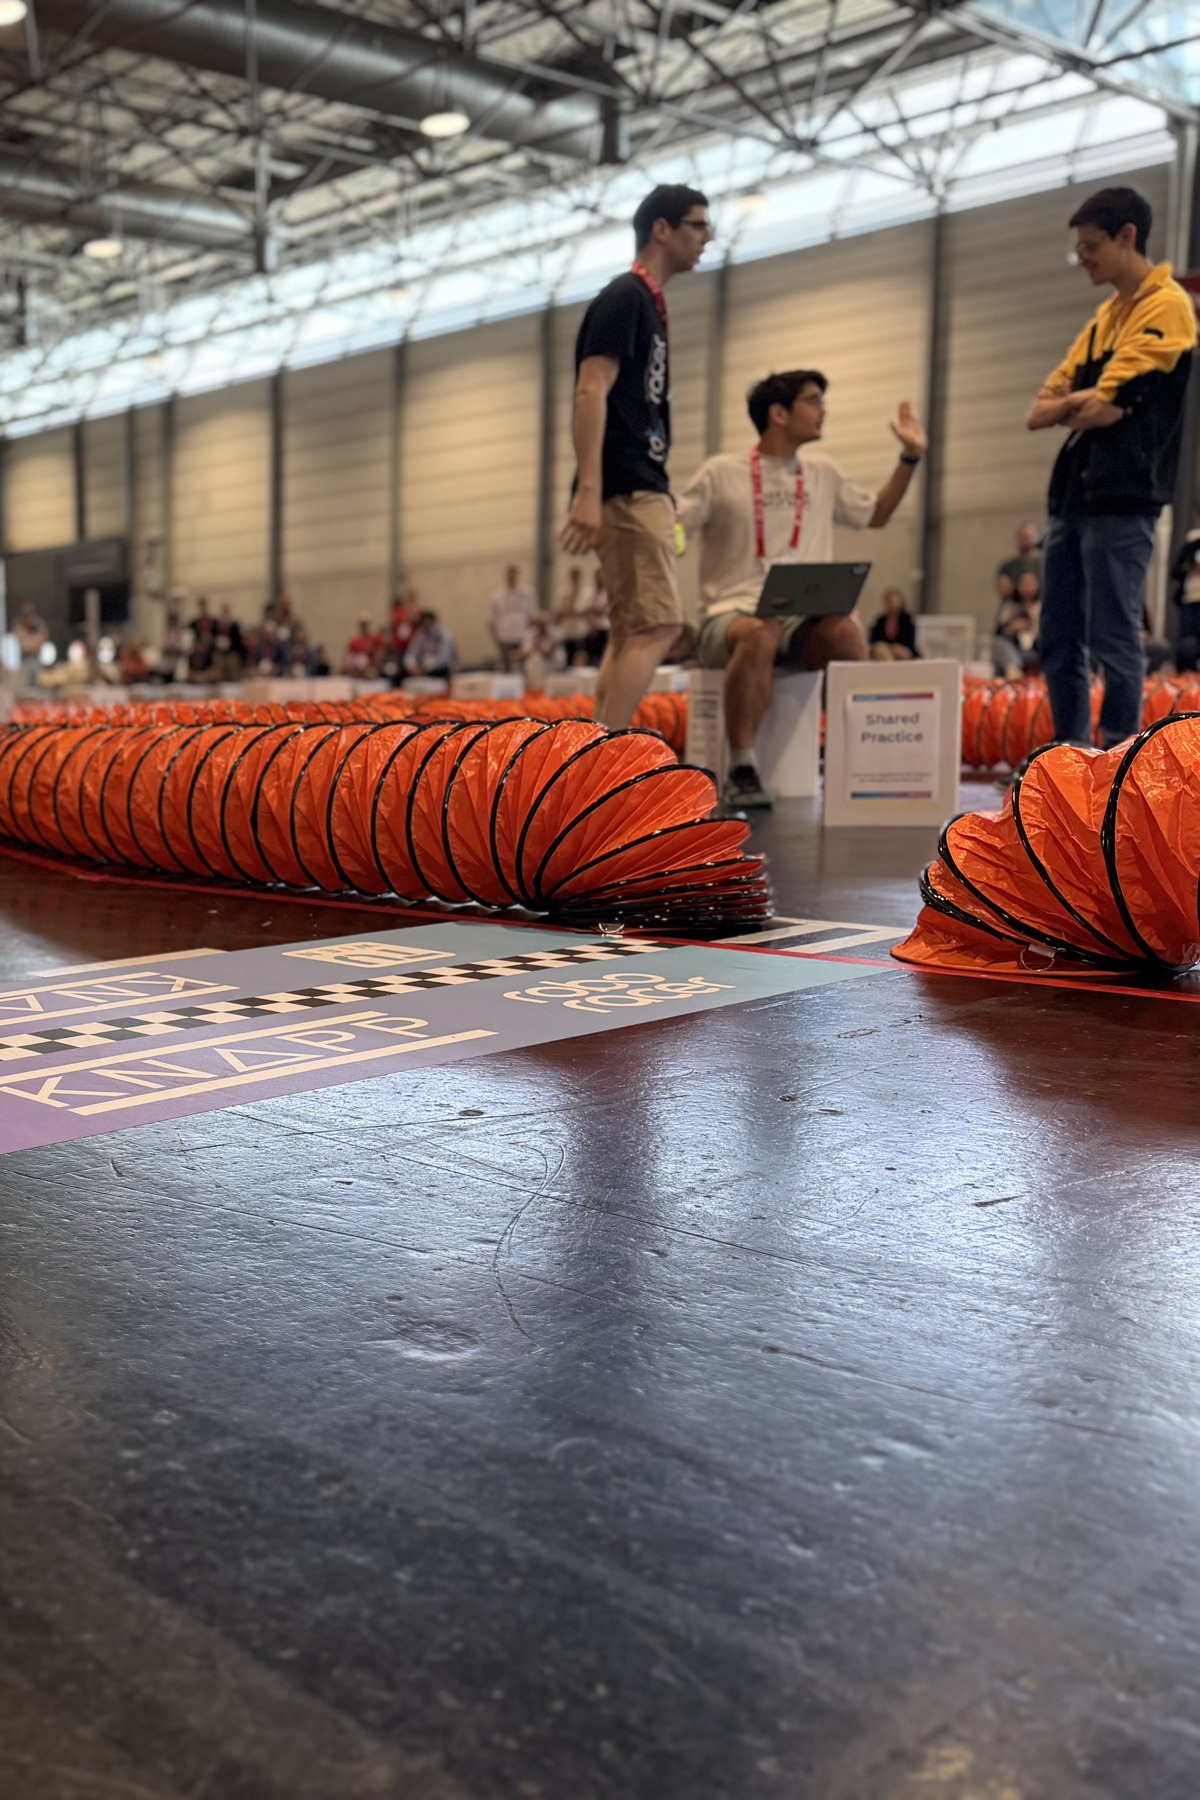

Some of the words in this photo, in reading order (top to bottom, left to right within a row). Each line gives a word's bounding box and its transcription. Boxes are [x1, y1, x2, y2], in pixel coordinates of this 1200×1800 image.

[865, 712, 920, 726] Shared
[861, 731, 924, 743] Practice
[503, 973, 666, 1003] robo
[563, 976, 736, 1013] racer
